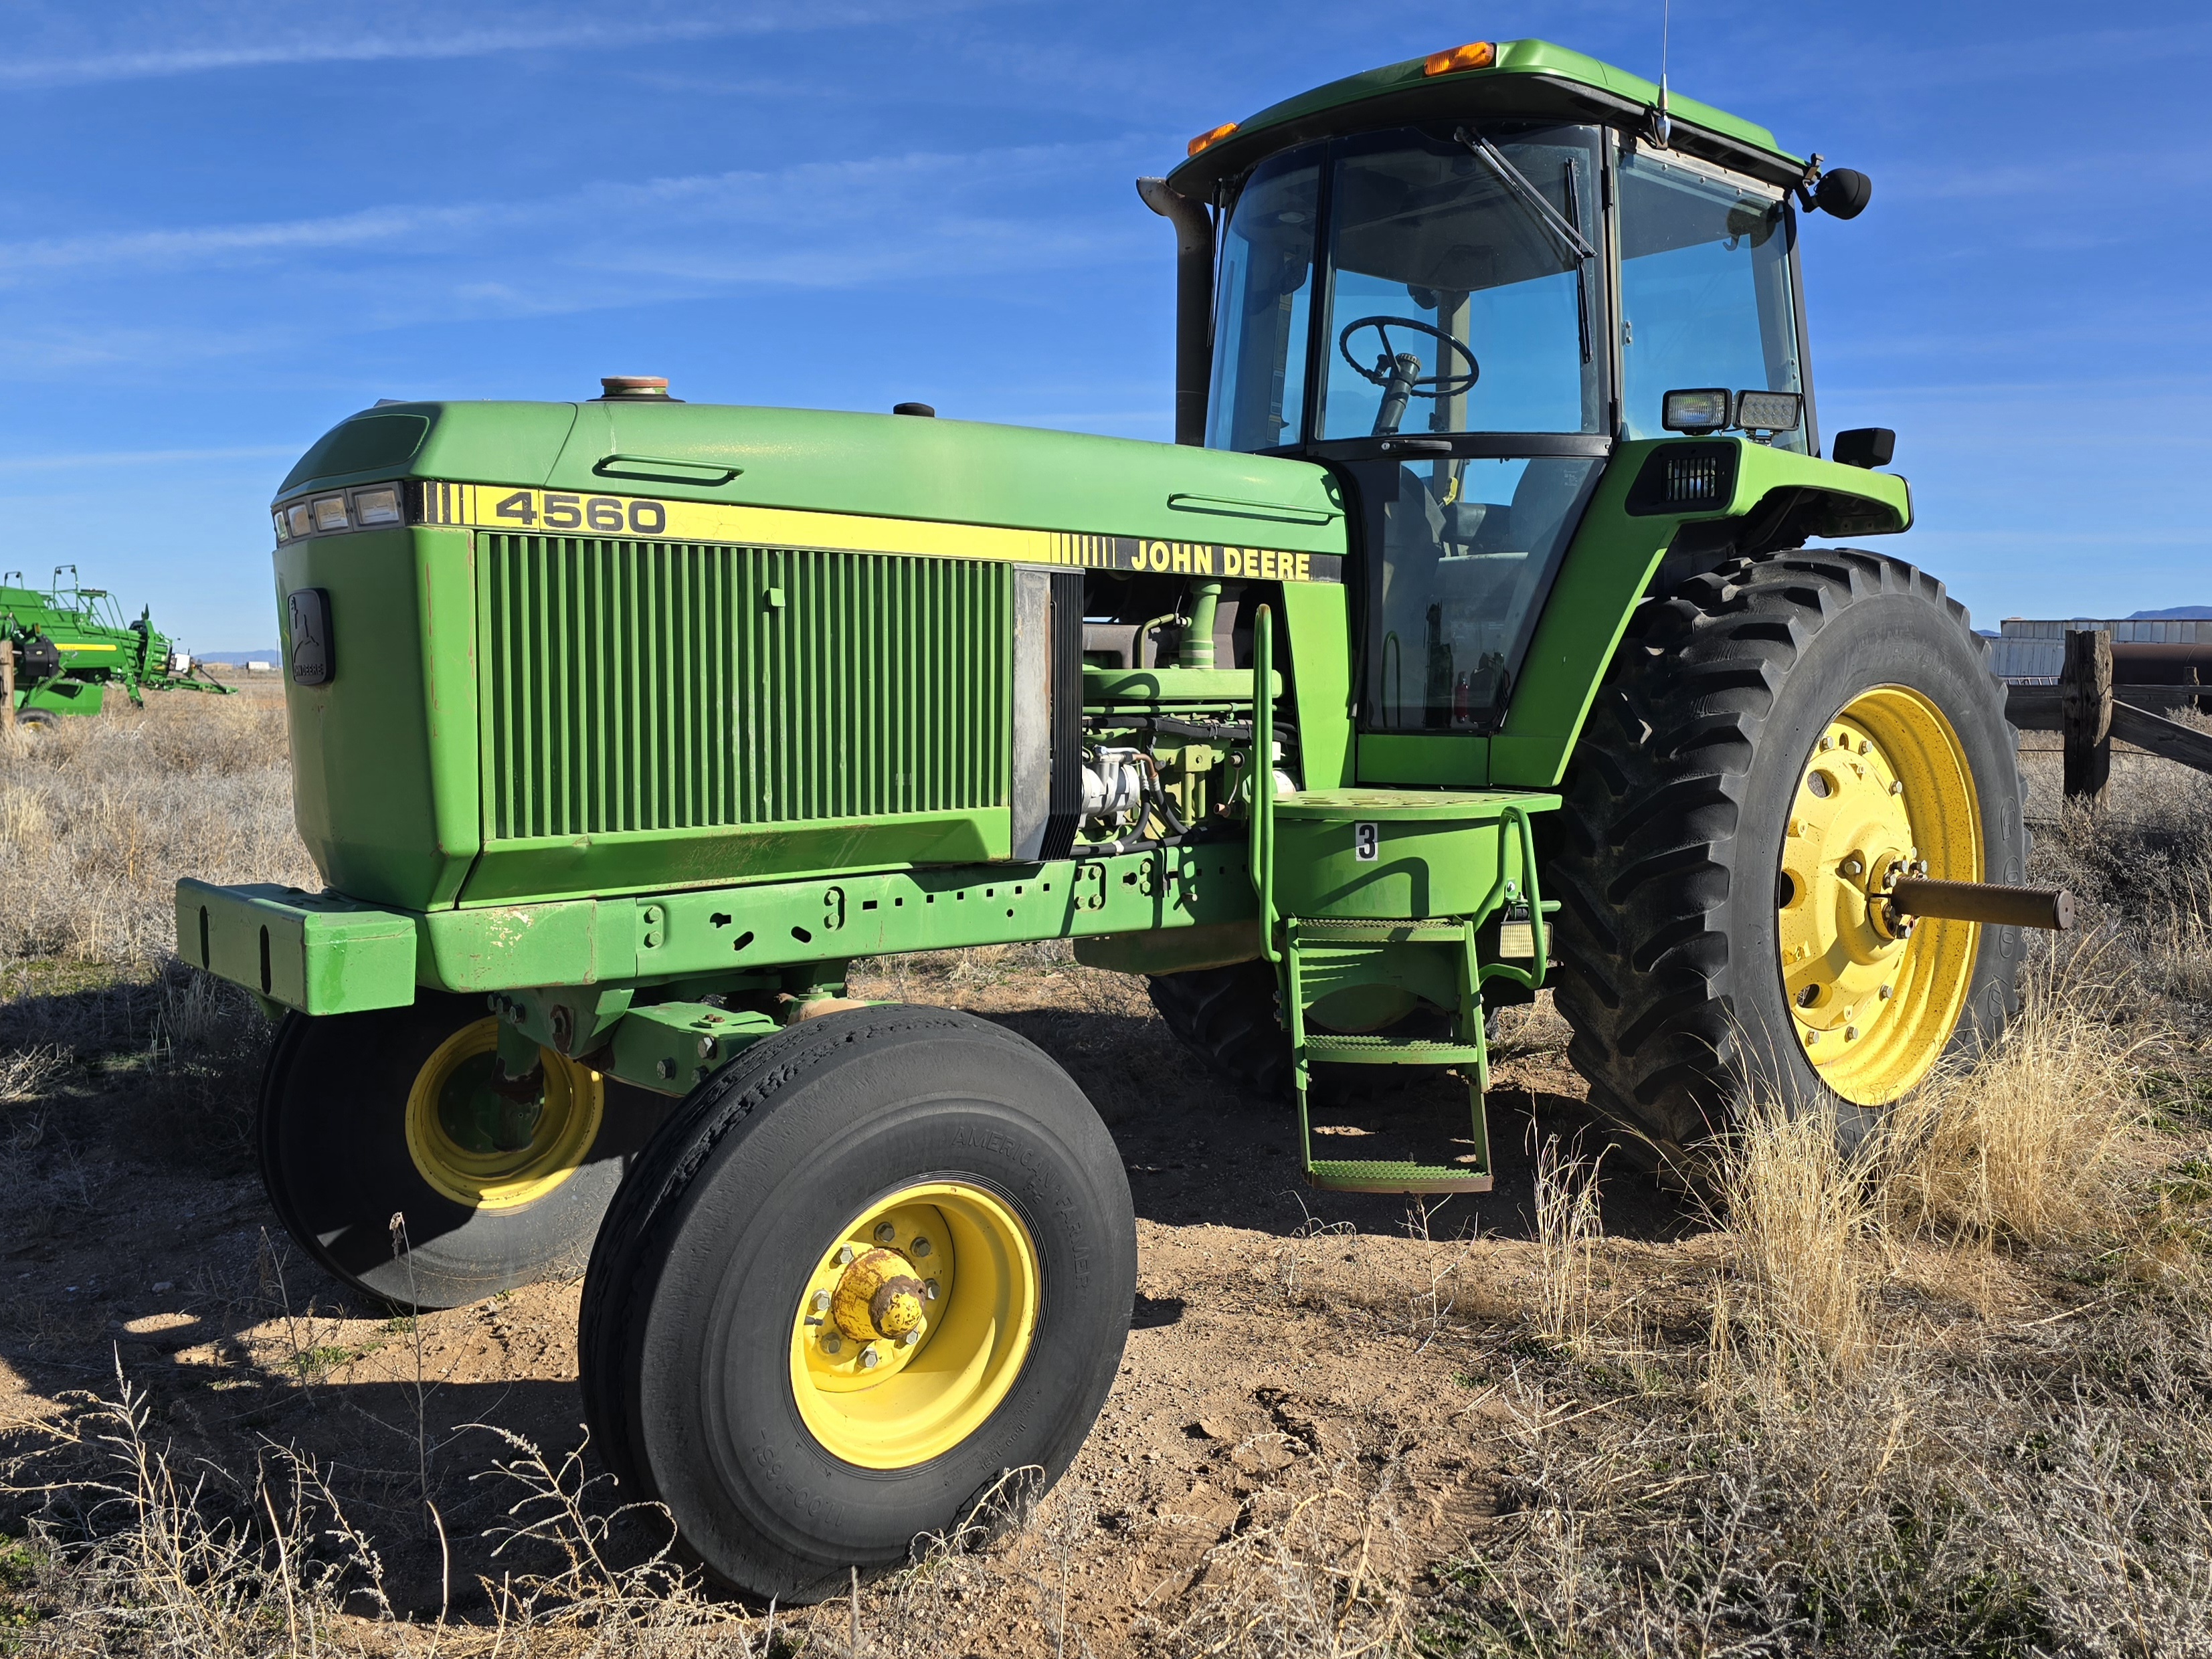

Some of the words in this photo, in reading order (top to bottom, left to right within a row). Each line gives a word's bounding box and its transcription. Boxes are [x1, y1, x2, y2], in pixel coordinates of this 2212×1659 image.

[496, 492, 665, 533] 4560
[1131, 541, 1212, 575] JOHN
[1224, 547, 1310, 581] DEERE
[1359, 824, 1376, 859] 3
[951, 1126, 1057, 1189] AMERICAN
[1056, 1192, 1090, 1289] FARMER
